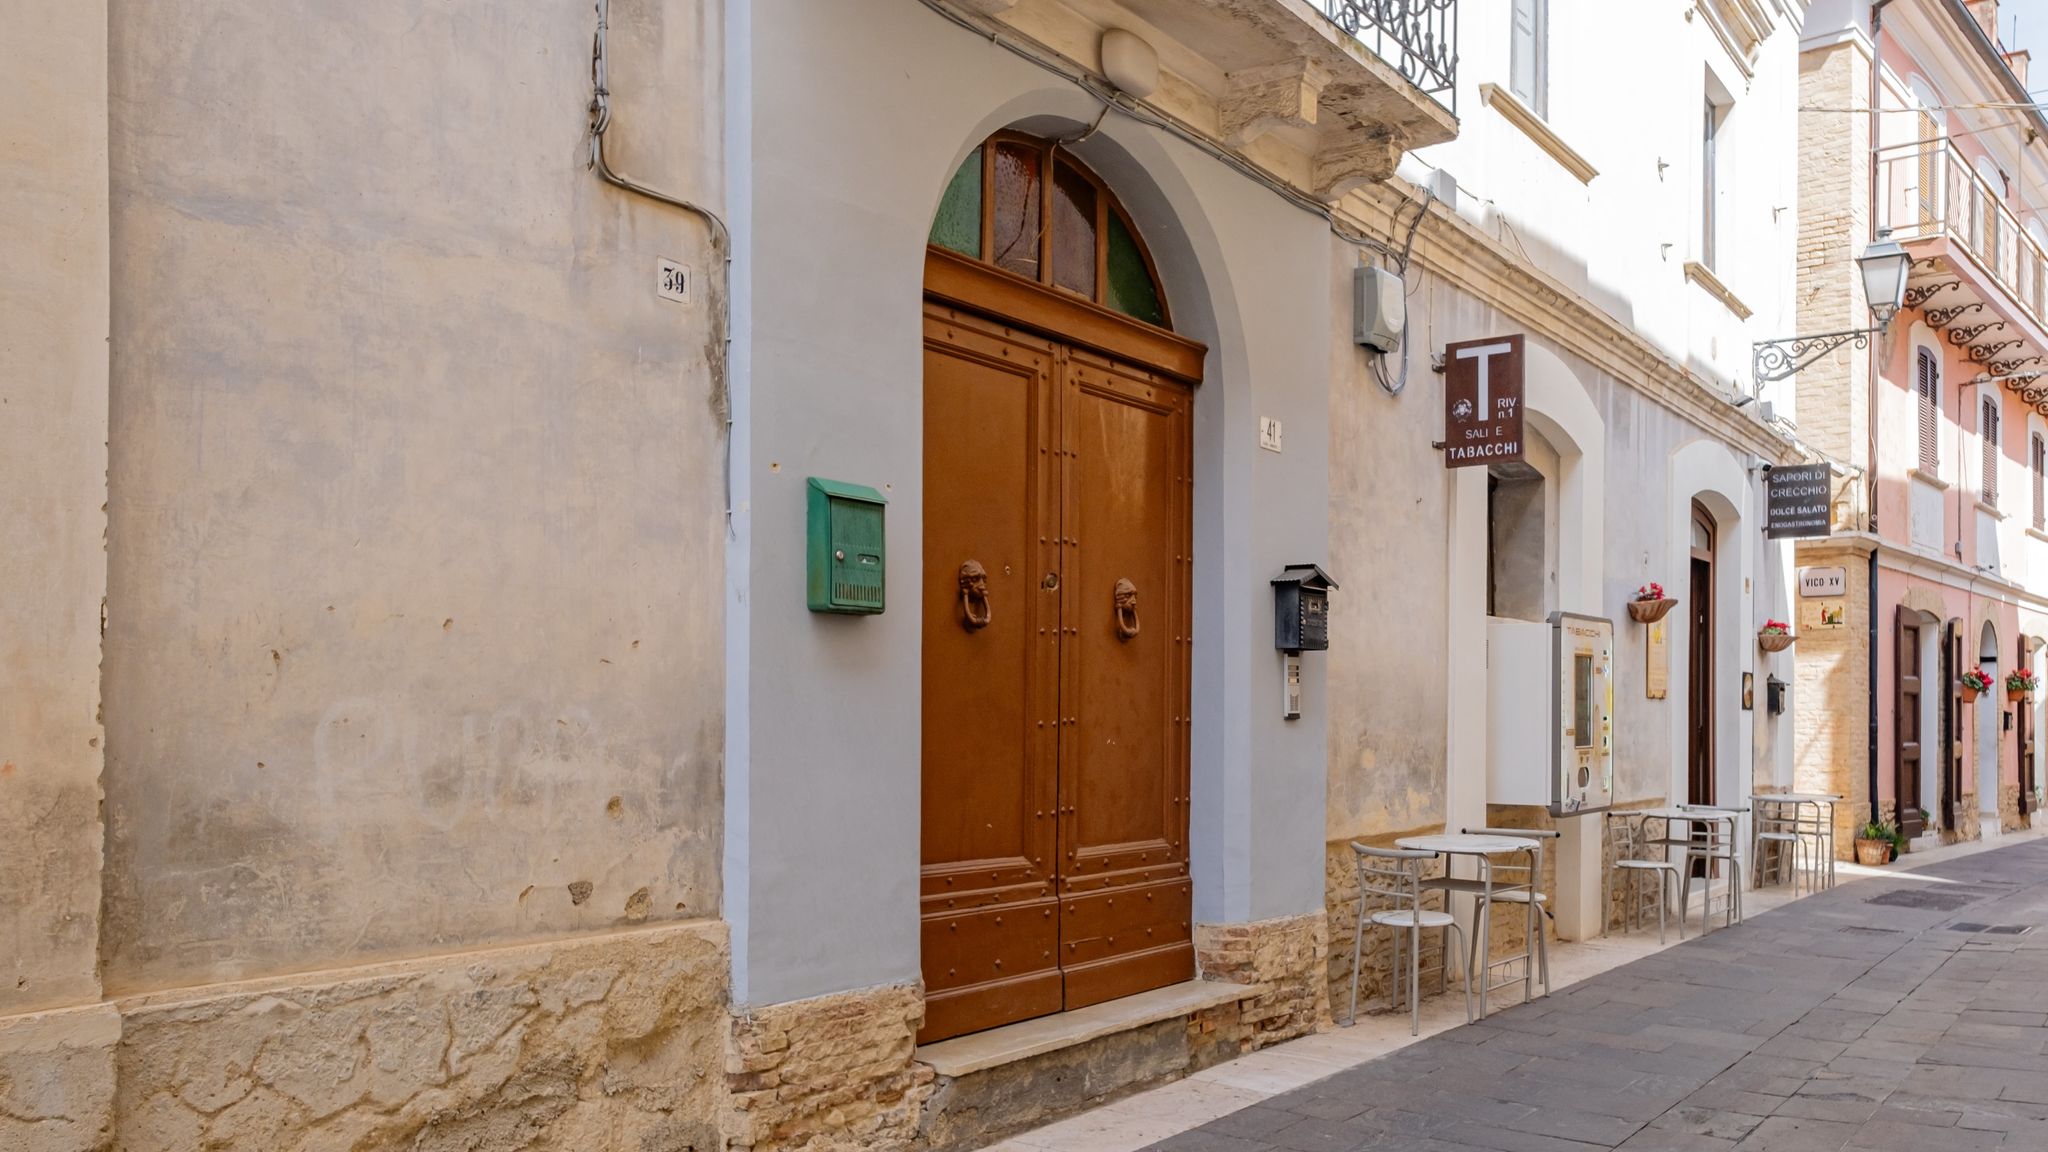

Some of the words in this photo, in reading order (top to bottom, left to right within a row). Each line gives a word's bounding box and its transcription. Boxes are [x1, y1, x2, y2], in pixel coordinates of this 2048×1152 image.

[664, 267, 684, 294] 39
[1456, 342, 1511, 421] T
[1267, 420, 1276, 443] 41
[1465, 428, 1488, 439] SALI
[1495, 426, 1503, 436] E
[1449, 441, 1517, 459] TABACCHI
[1772, 471, 1812, 483] SAPORI
[1814, 471, 1826, 480] DI
[1770, 485, 1827, 498] CRECCHIO
[1770, 506, 1796, 516] DOLCE
[1797, 504, 1827, 514] SALATO
[1805, 577, 1824, 587] VICO
[1829, 576, 1840, 586] XV
